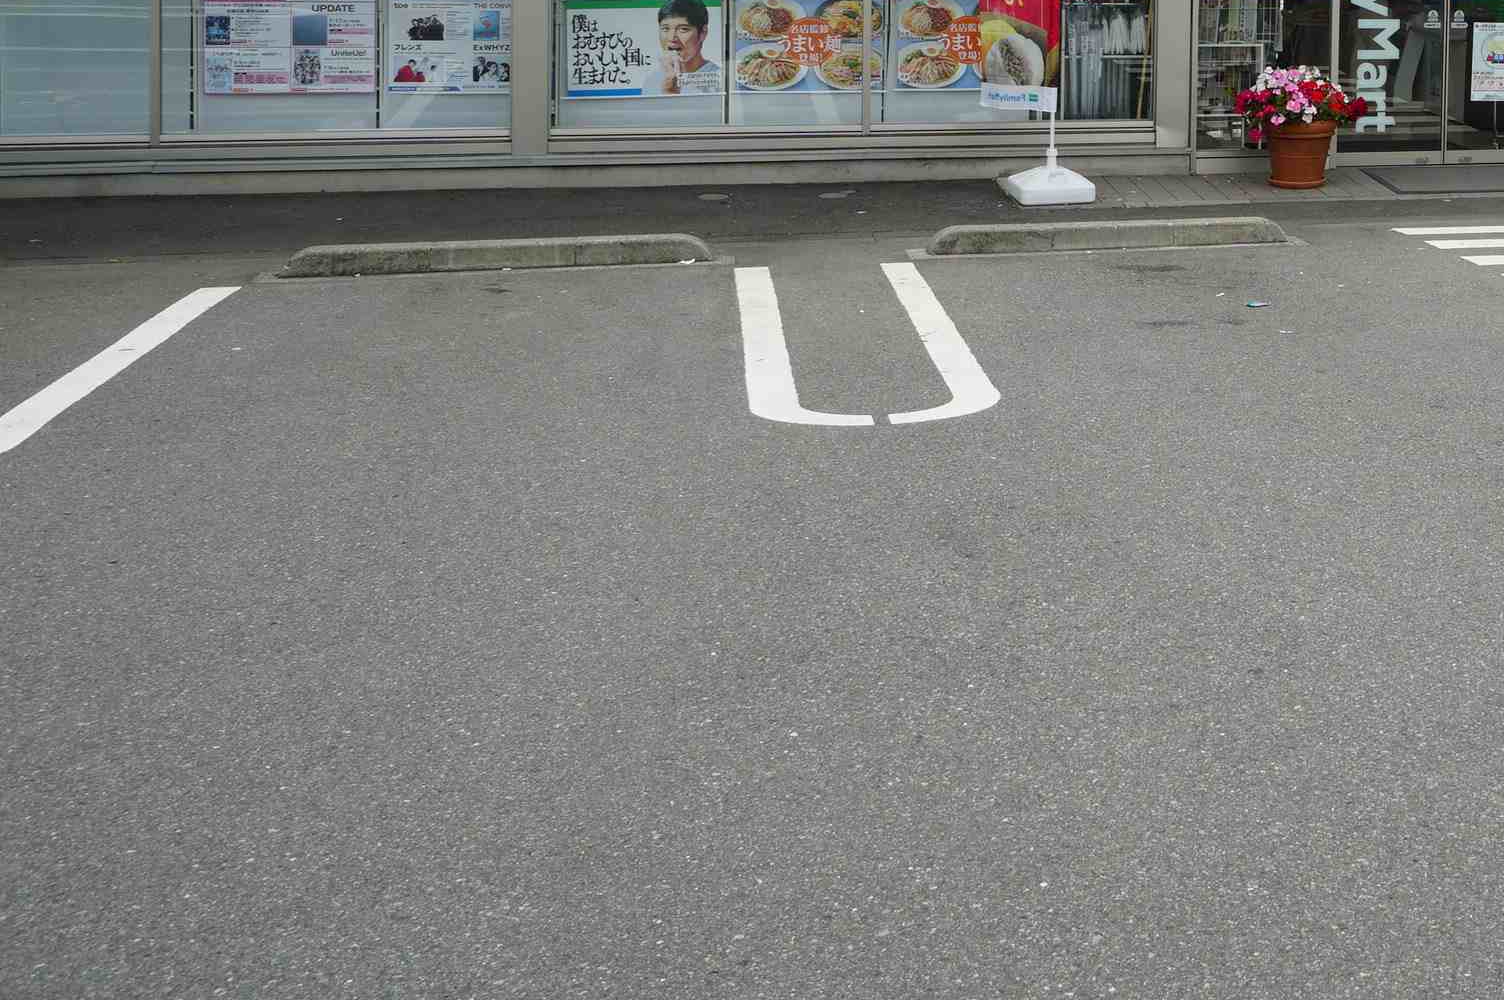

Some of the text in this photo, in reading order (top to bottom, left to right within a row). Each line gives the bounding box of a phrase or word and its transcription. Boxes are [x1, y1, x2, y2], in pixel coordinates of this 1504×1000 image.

[311, 4, 355, 13] UPDATE
[572, 14, 599, 34] 僕は
[572, 31, 633, 49] おむすびの
[936, 34, 981, 51] うまい
[573, 48, 652, 67] おいしい国に
